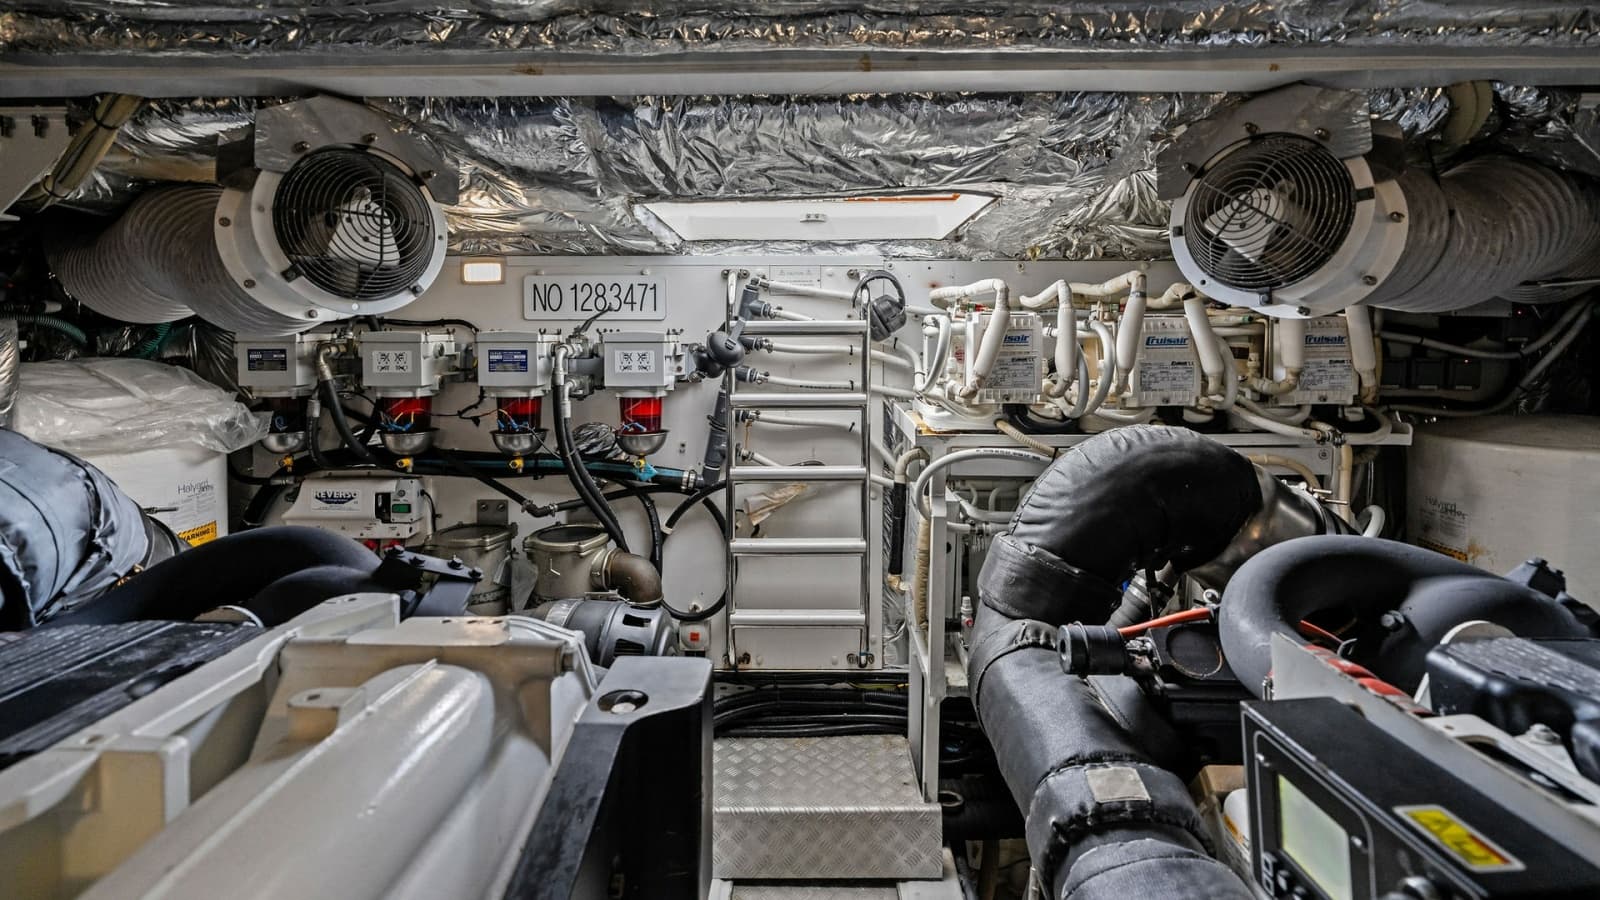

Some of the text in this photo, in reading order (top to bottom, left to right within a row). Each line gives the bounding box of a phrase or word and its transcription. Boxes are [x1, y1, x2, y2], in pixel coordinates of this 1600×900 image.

[533, 282, 657, 312] NO 1283471
[1145, 336, 1190, 346] Cruisair
[1304, 334, 1347, 344] Cruisair
[313, 488, 358, 498] REVERSO
